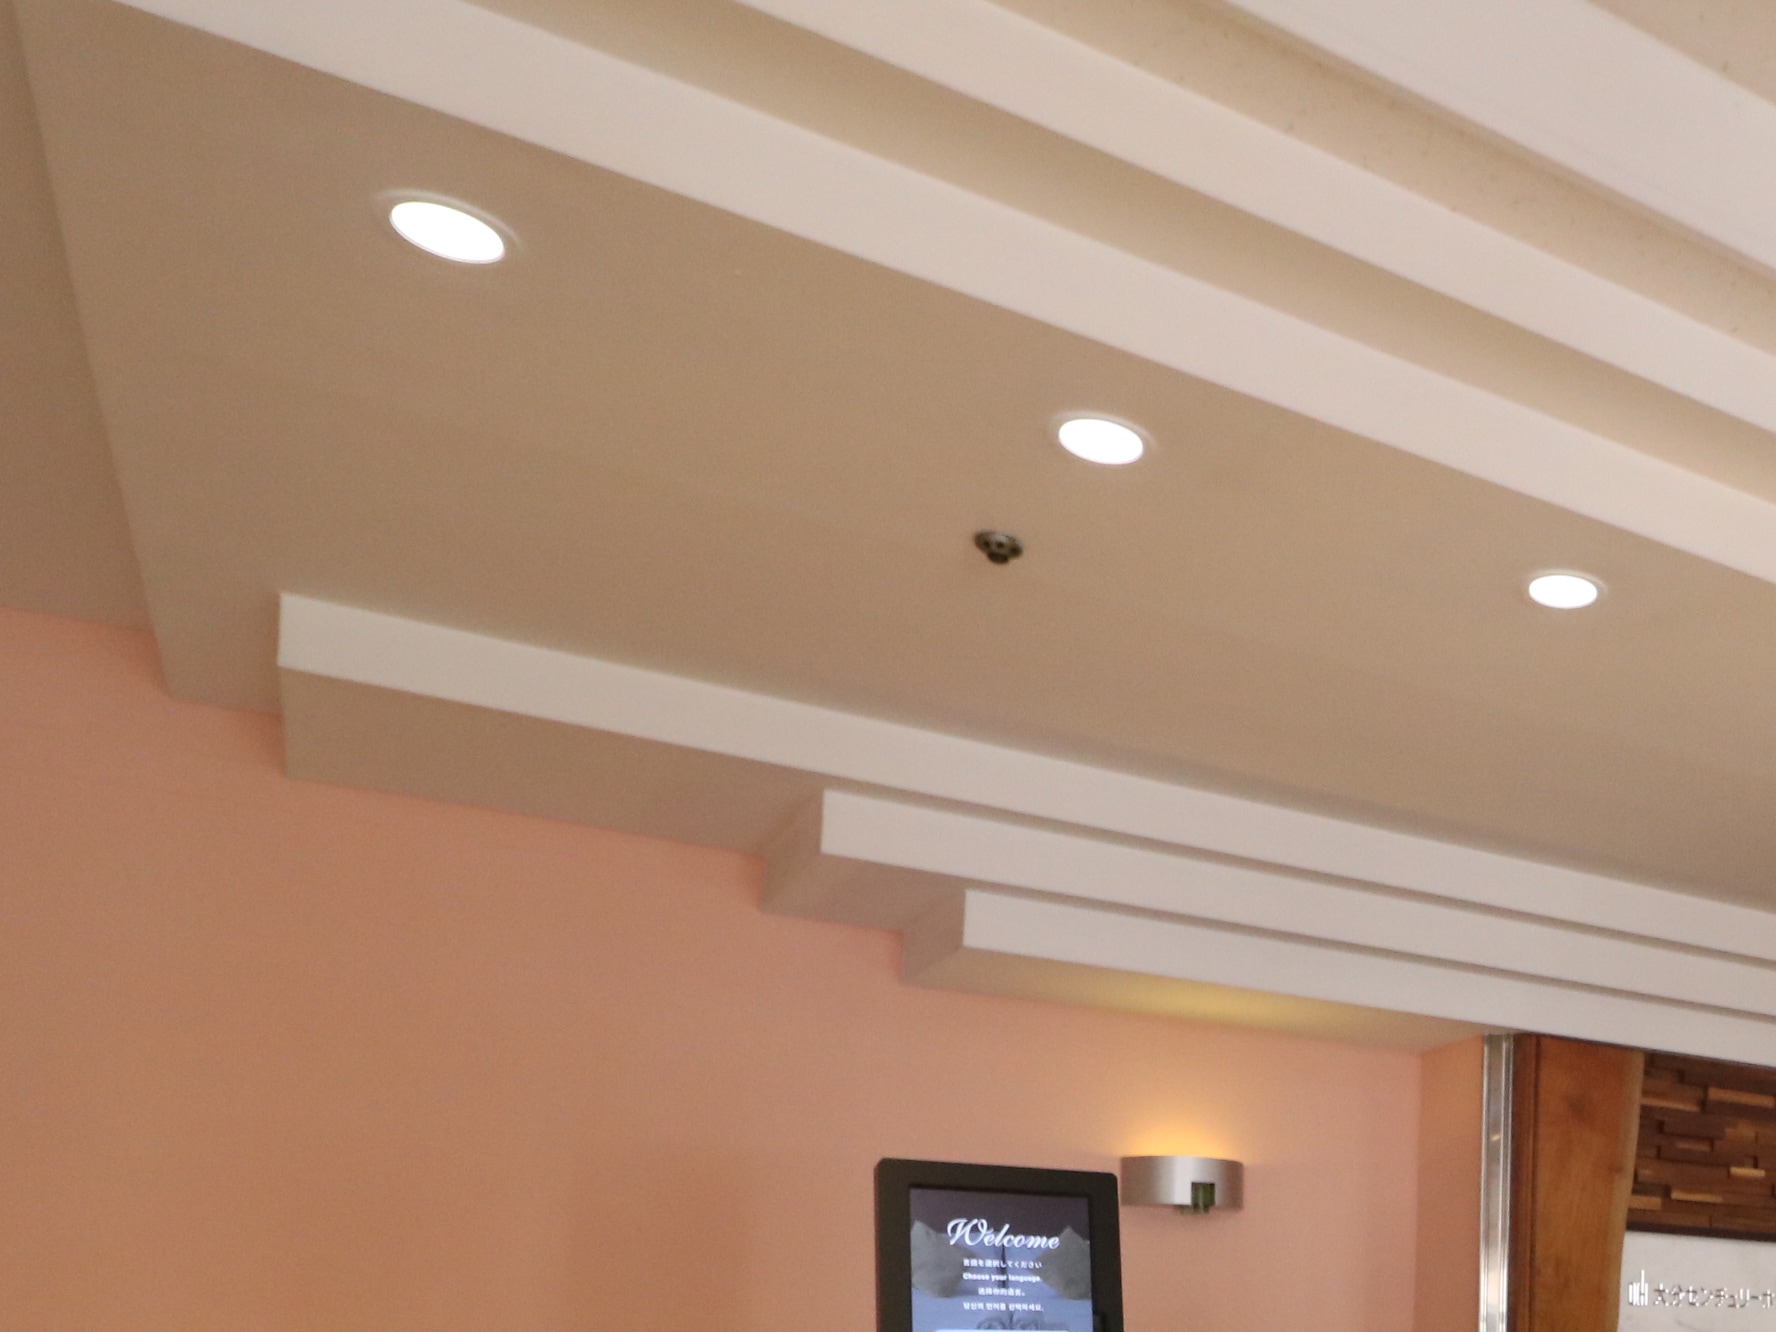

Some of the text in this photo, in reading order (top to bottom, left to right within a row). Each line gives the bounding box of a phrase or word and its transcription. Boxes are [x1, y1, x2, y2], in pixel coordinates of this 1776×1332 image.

[947, 1218, 1060, 1249] Welcome
[962, 1272, 990, 1281] Choose
[991, 1273, 1007, 1282] your
